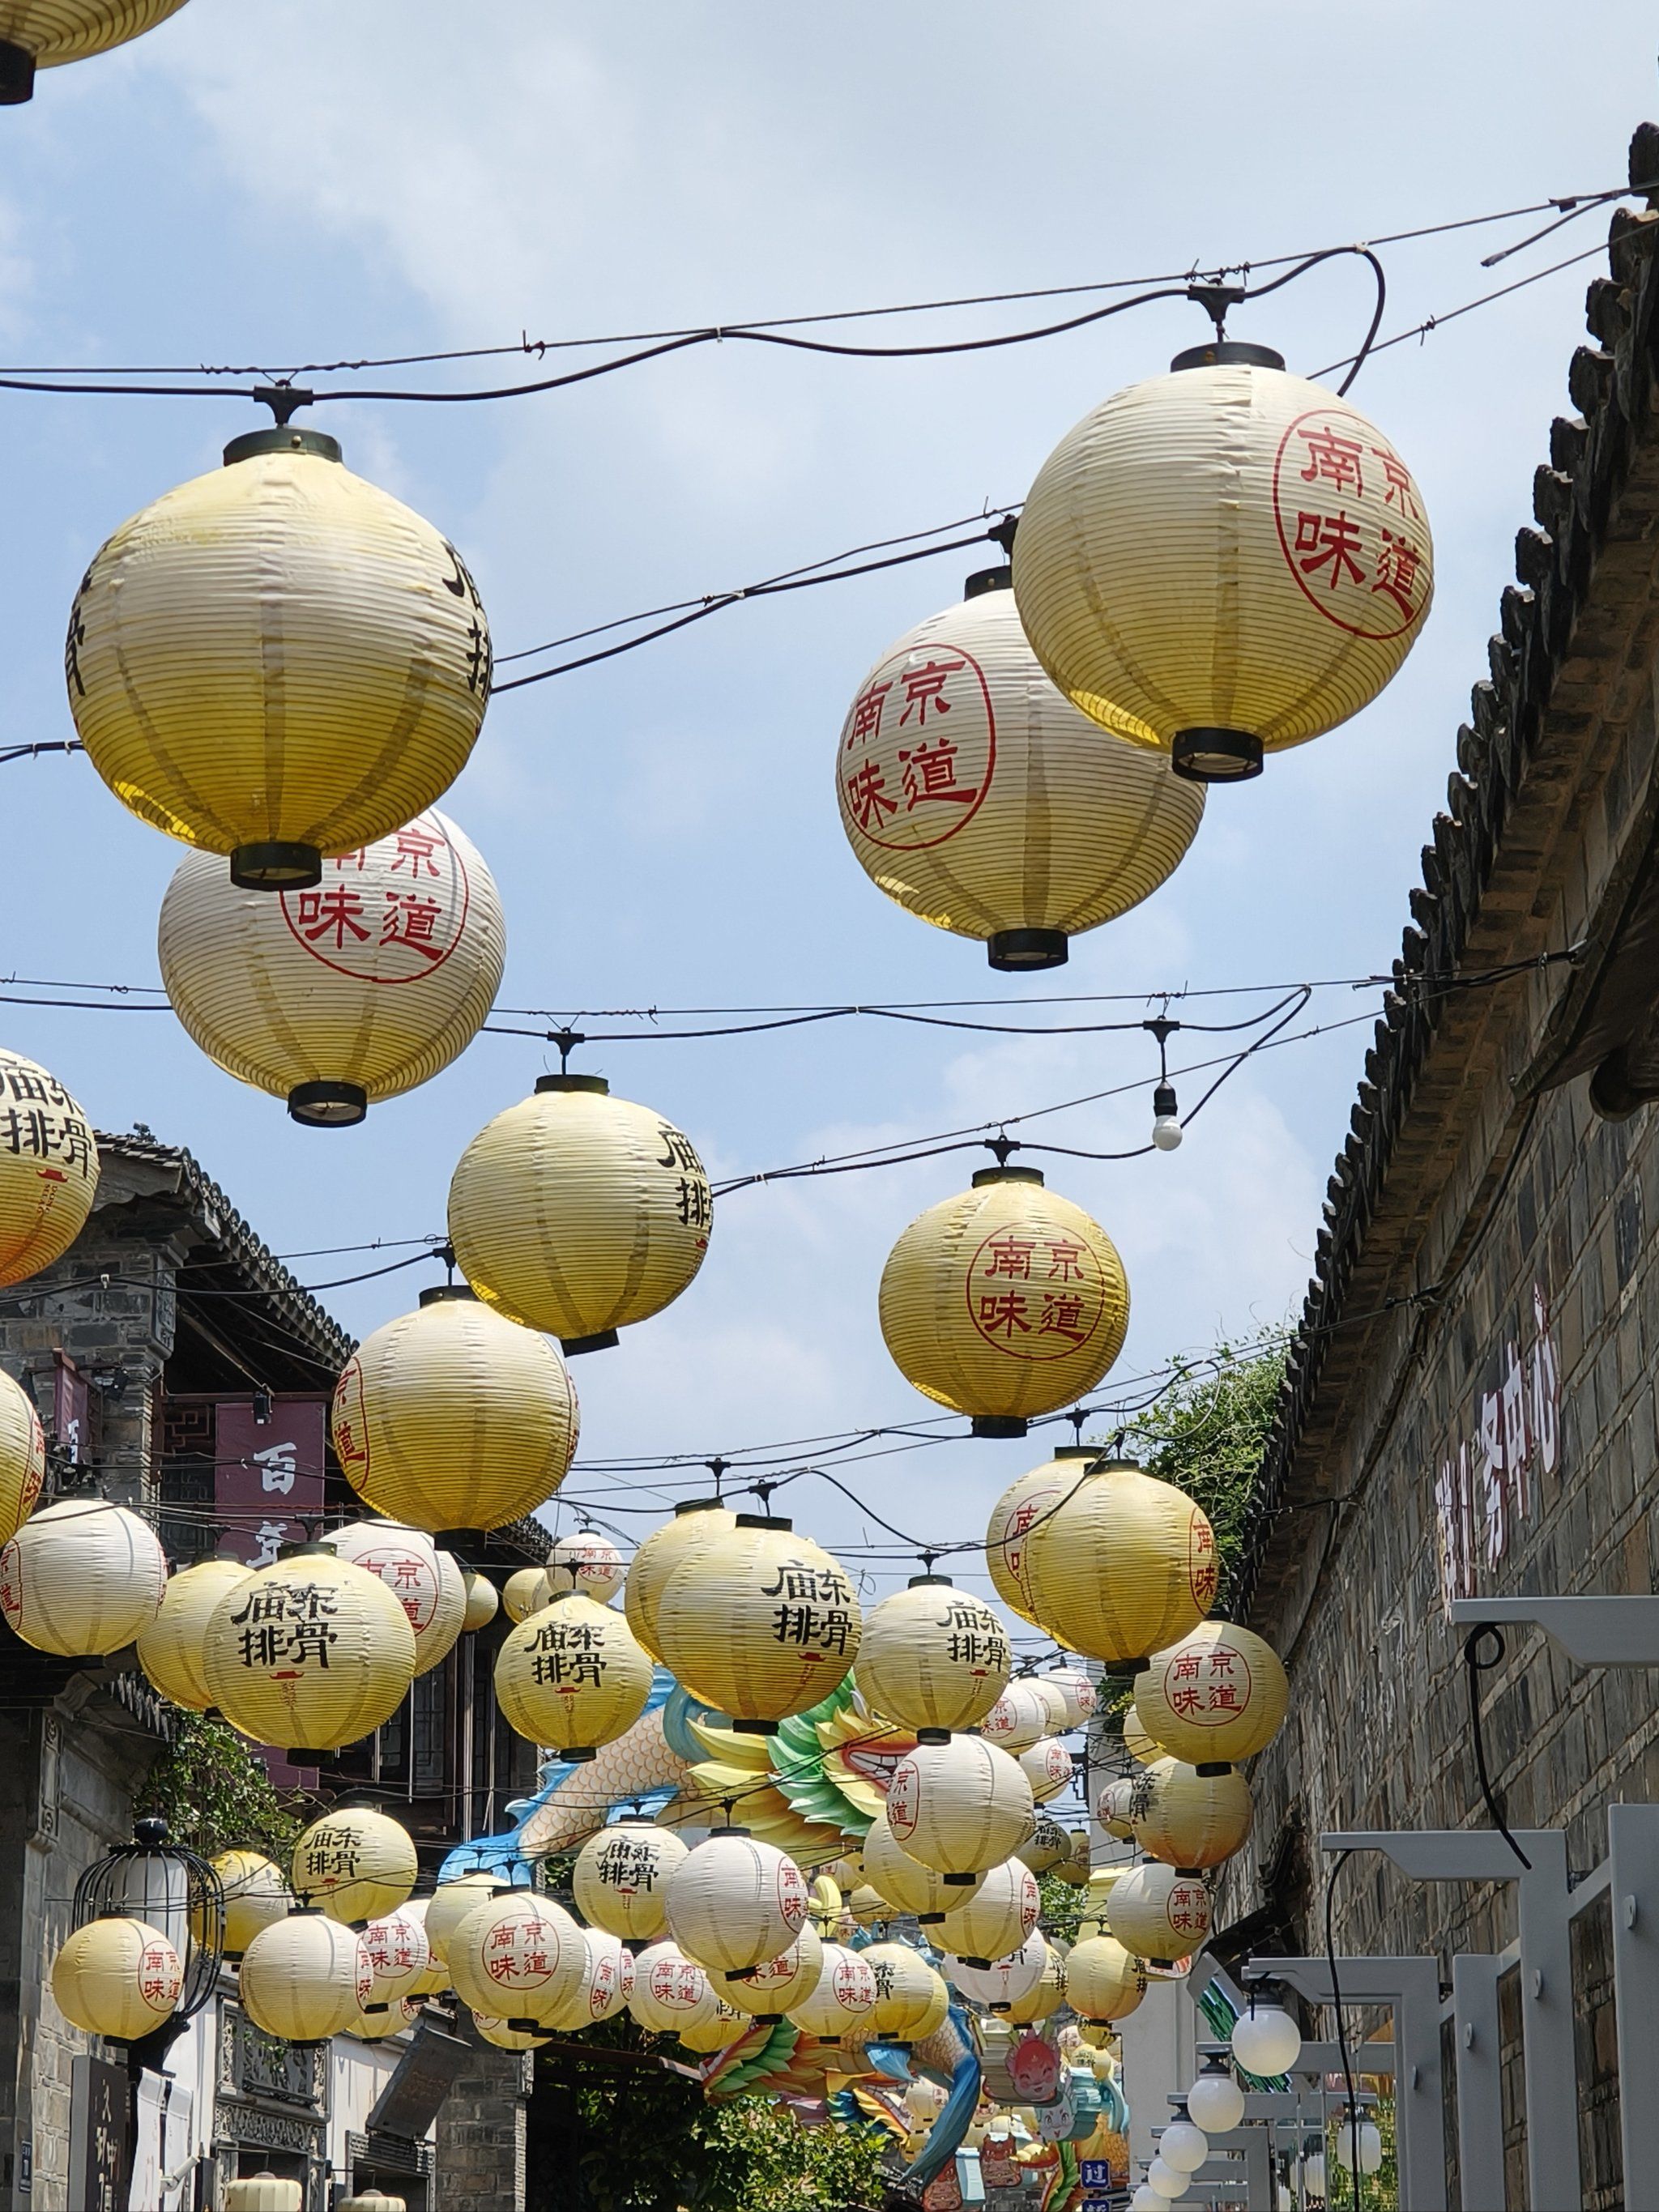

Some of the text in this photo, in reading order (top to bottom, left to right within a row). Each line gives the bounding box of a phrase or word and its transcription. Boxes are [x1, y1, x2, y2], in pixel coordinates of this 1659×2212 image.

[1298, 427, 1421, 519] 南京
[1295, 511, 1421, 623] 味道
[847, 662, 966, 752] 南京
[847, 740, 978, 830] 味道
[299, 884, 444, 961] 味道
[0, 1106, 92, 1179] 排骨
[984, 1235, 1087, 1282] 南京
[979, 1290, 1086, 1342] 味道
[761, 1559, 851, 1606] 庙东
[231, 1582, 339, 1624] 庙东
[936, 1600, 1004, 1634] 庙东
[237, 1622, 338, 1669] 排骨
[523, 1621, 606, 1652] 庙东
[772, 1605, 852, 1656] 排骨
[947, 1633, 1006, 1673] 排骨
[1173, 1652, 1238, 1681] 南京
[531, 1652, 608, 1687] 排骨
[1172, 1684, 1242, 1715] 味道
[887, 1801, 914, 1828] 道
[304, 1825, 364, 1850] 庙东
[306, 1850, 360, 1877] 排骨
[597, 1861, 659, 1892] 排骨
[1174, 1887, 1206, 1907] 南京
[368, 1924, 411, 1945] 南京
[491, 1920, 547, 1950] 南京
[1174, 1910, 1208, 1932] 味道
[145, 1949, 181, 1971] 南京
[369, 1948, 413, 1970] 味道
[490, 1952, 552, 1981] 味道
[656, 1961, 696, 1980] 南京
[839, 1966, 871, 1981] 南京
[144, 1977, 181, 2001] 味道
[655, 1983, 697, 2004] 味道
[838, 1985, 872, 2004] 味道
